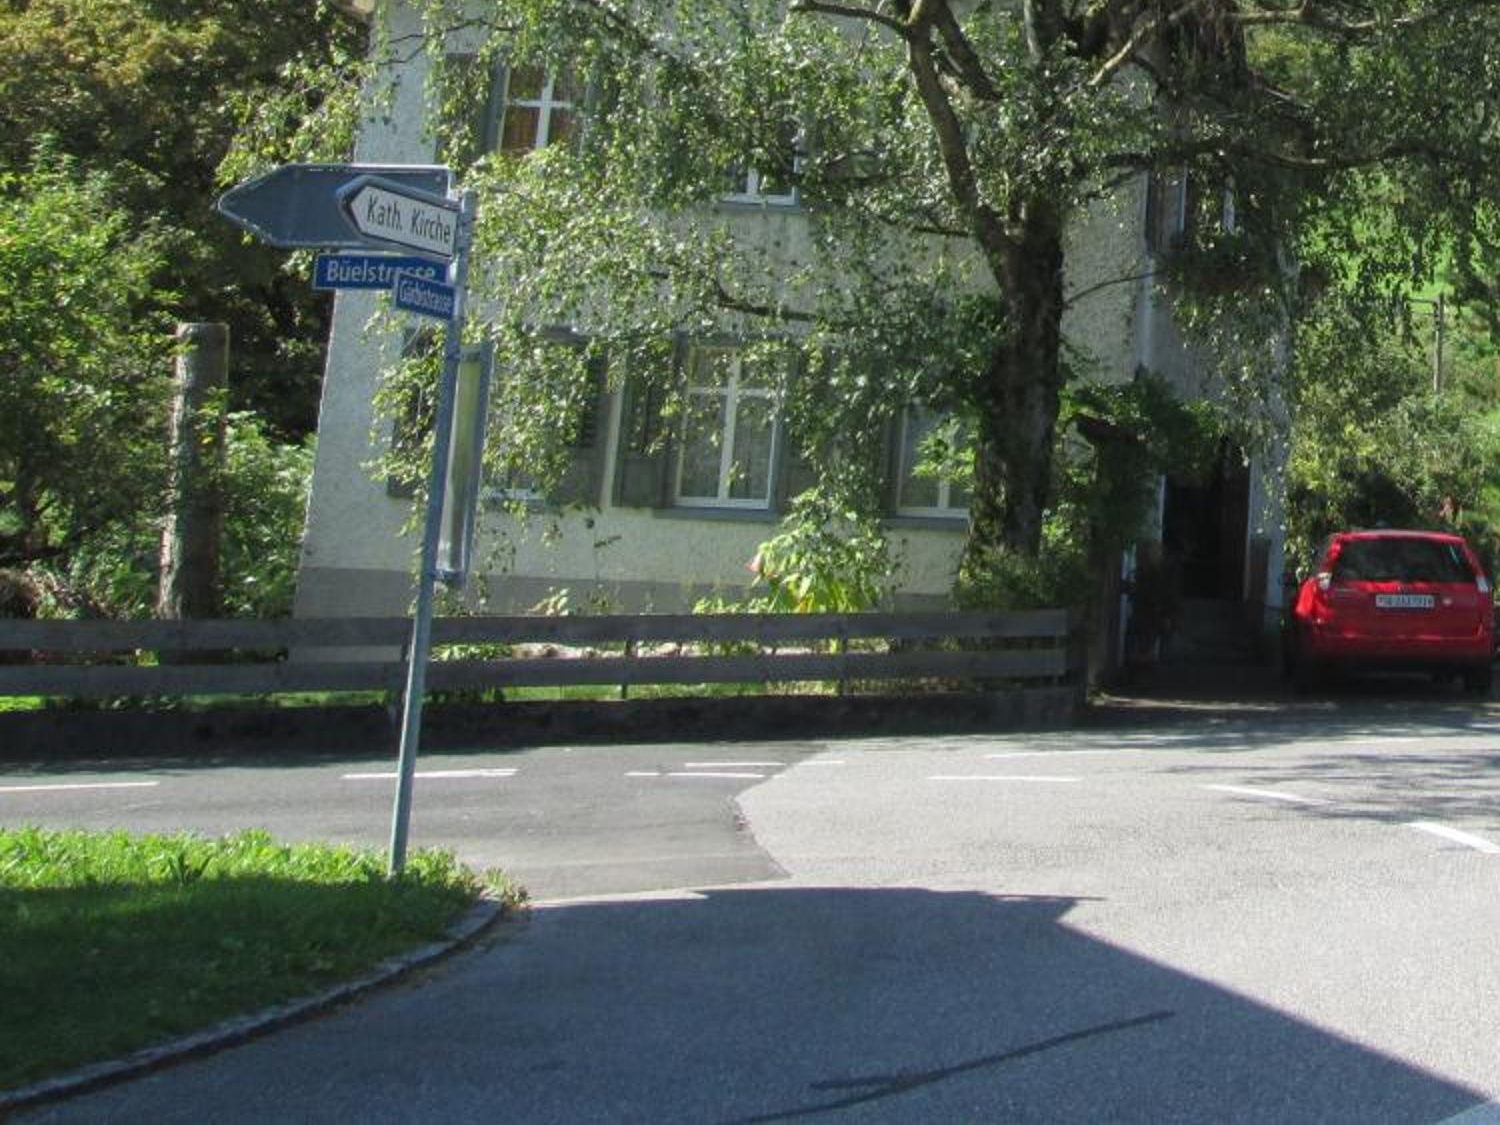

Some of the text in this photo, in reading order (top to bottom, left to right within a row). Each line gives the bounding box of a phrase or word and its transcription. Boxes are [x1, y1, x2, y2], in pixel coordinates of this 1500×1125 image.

[366, 194, 451, 244] Kath. Kirche
[327, 259, 435, 283] Büelstrsse
